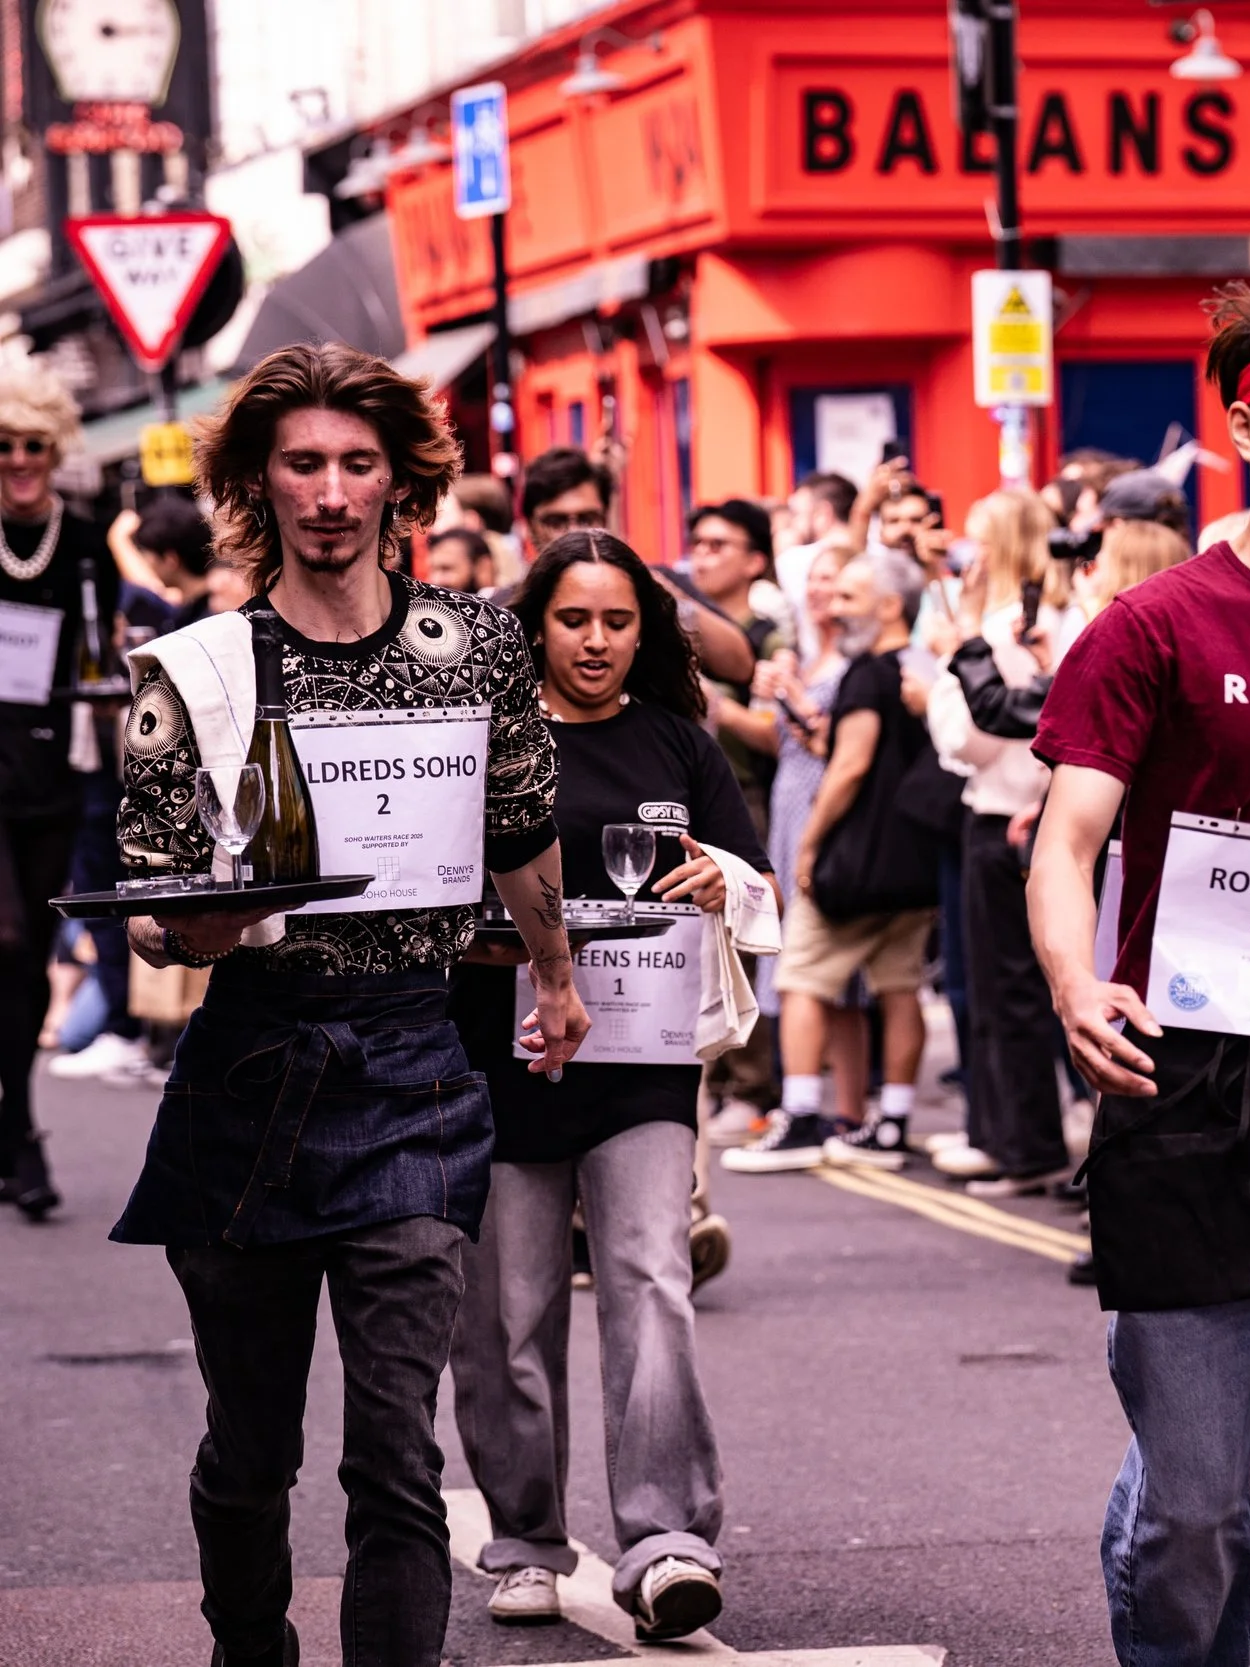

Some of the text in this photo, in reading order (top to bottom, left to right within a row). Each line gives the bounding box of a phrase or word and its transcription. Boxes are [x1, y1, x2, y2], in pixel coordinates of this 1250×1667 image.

[109, 234, 191, 259] GIVE
[126, 267, 178, 286] WAY
[302, 755, 477, 784] LDREDS SOHO
[377, 794, 391, 815] 2
[643, 806, 671, 818] GIPSY
[364, 834, 392, 842] WAITERS
[442, 875, 471, 885] BRANDS
[360, 888, 418, 899] SOHO HOUSE
[572, 950, 686, 969] EENS HEAD
[614, 978, 625, 995] 1
